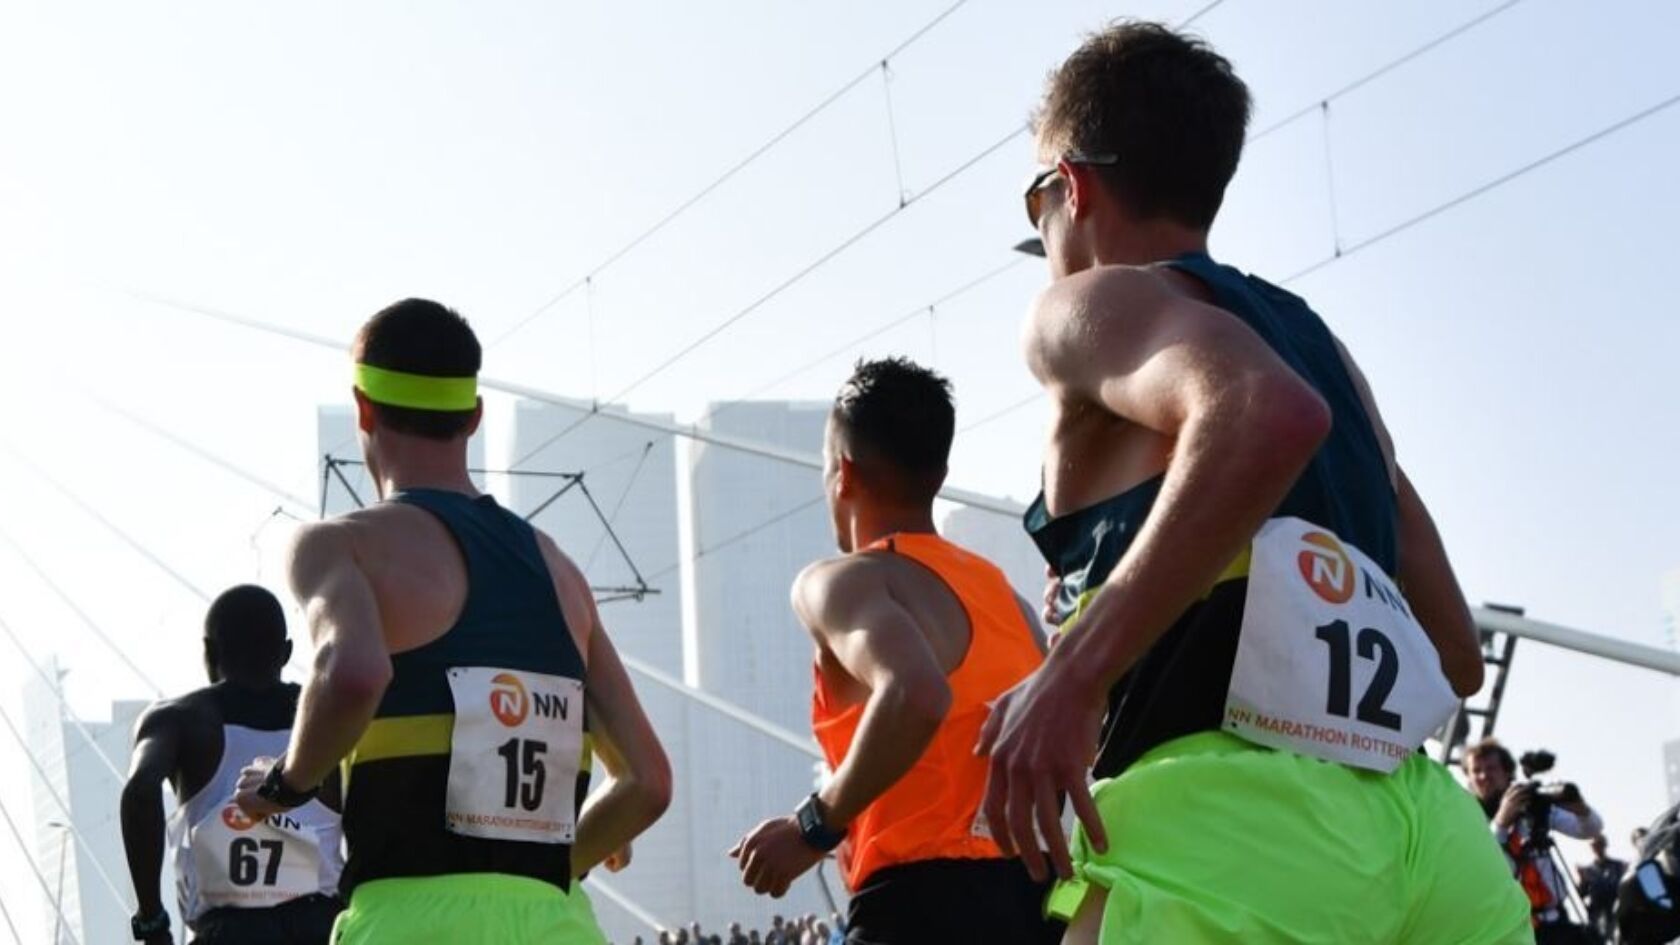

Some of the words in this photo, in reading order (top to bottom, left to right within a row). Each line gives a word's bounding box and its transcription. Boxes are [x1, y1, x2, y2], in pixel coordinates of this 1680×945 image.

[1315, 619, 1402, 731] 12
[532, 691, 569, 721] NN
[1228, 707, 1250, 725] NN
[1255, 714, 1346, 745] MARATHON
[498, 737, 548, 812] 15
[229, 837, 285, 887] 67
